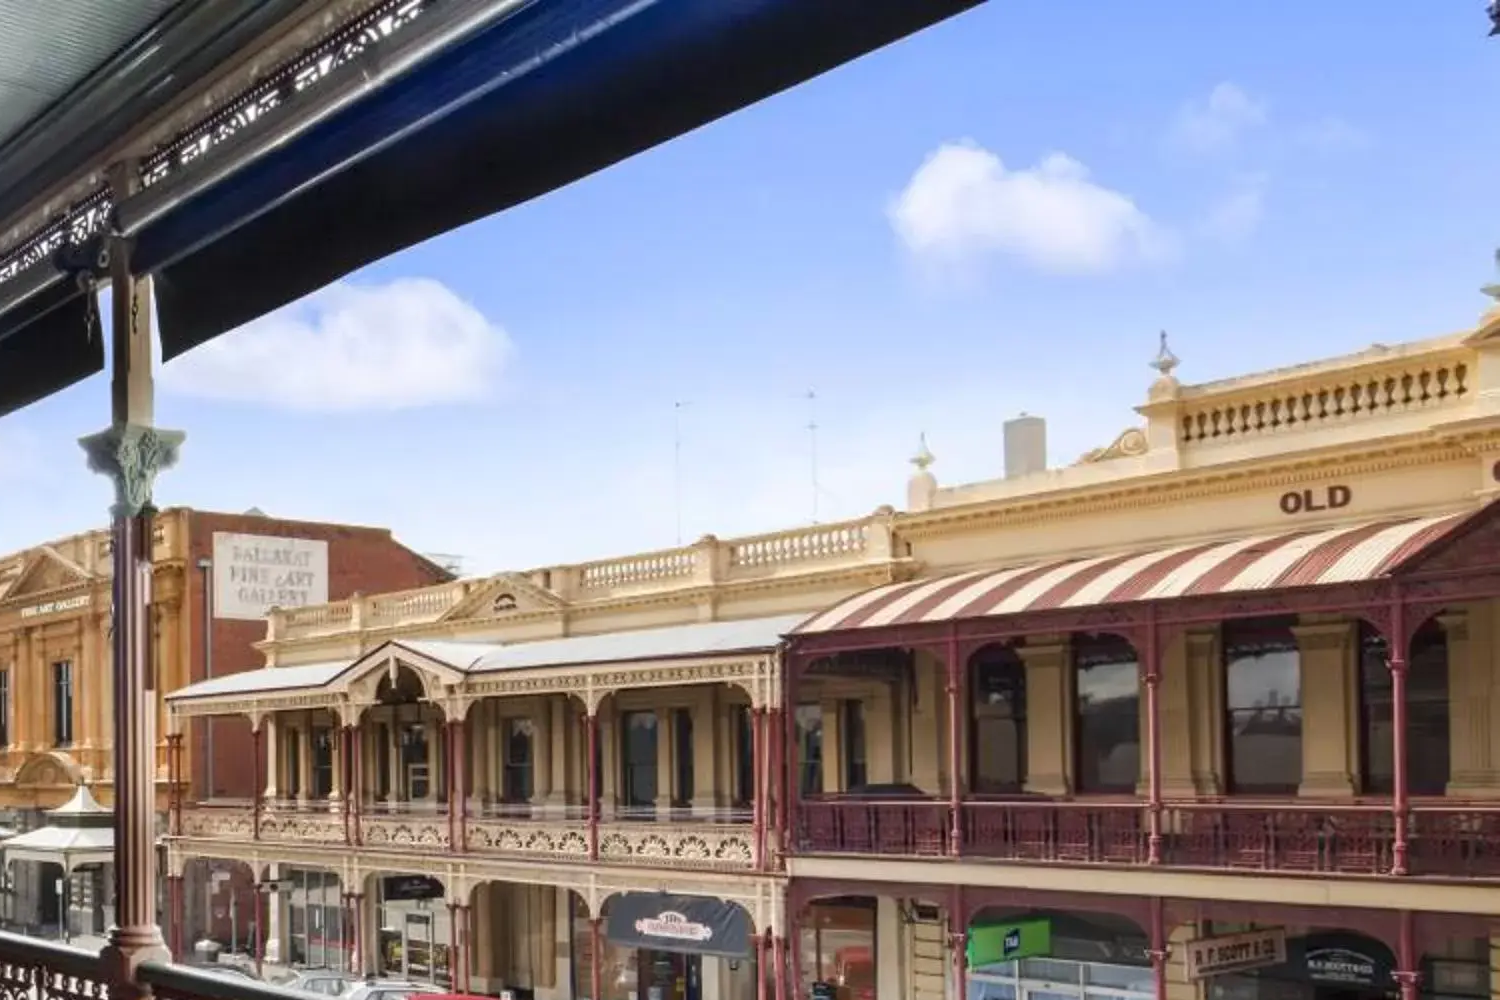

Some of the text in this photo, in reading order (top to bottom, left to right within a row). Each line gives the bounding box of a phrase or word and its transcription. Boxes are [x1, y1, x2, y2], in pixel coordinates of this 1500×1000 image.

[1279, 484, 1352, 515] OLD
[229, 565, 315, 588] FINE ART
[237, 586, 309, 606] GALLERY
[1218, 942, 1251, 961] SCOTT
